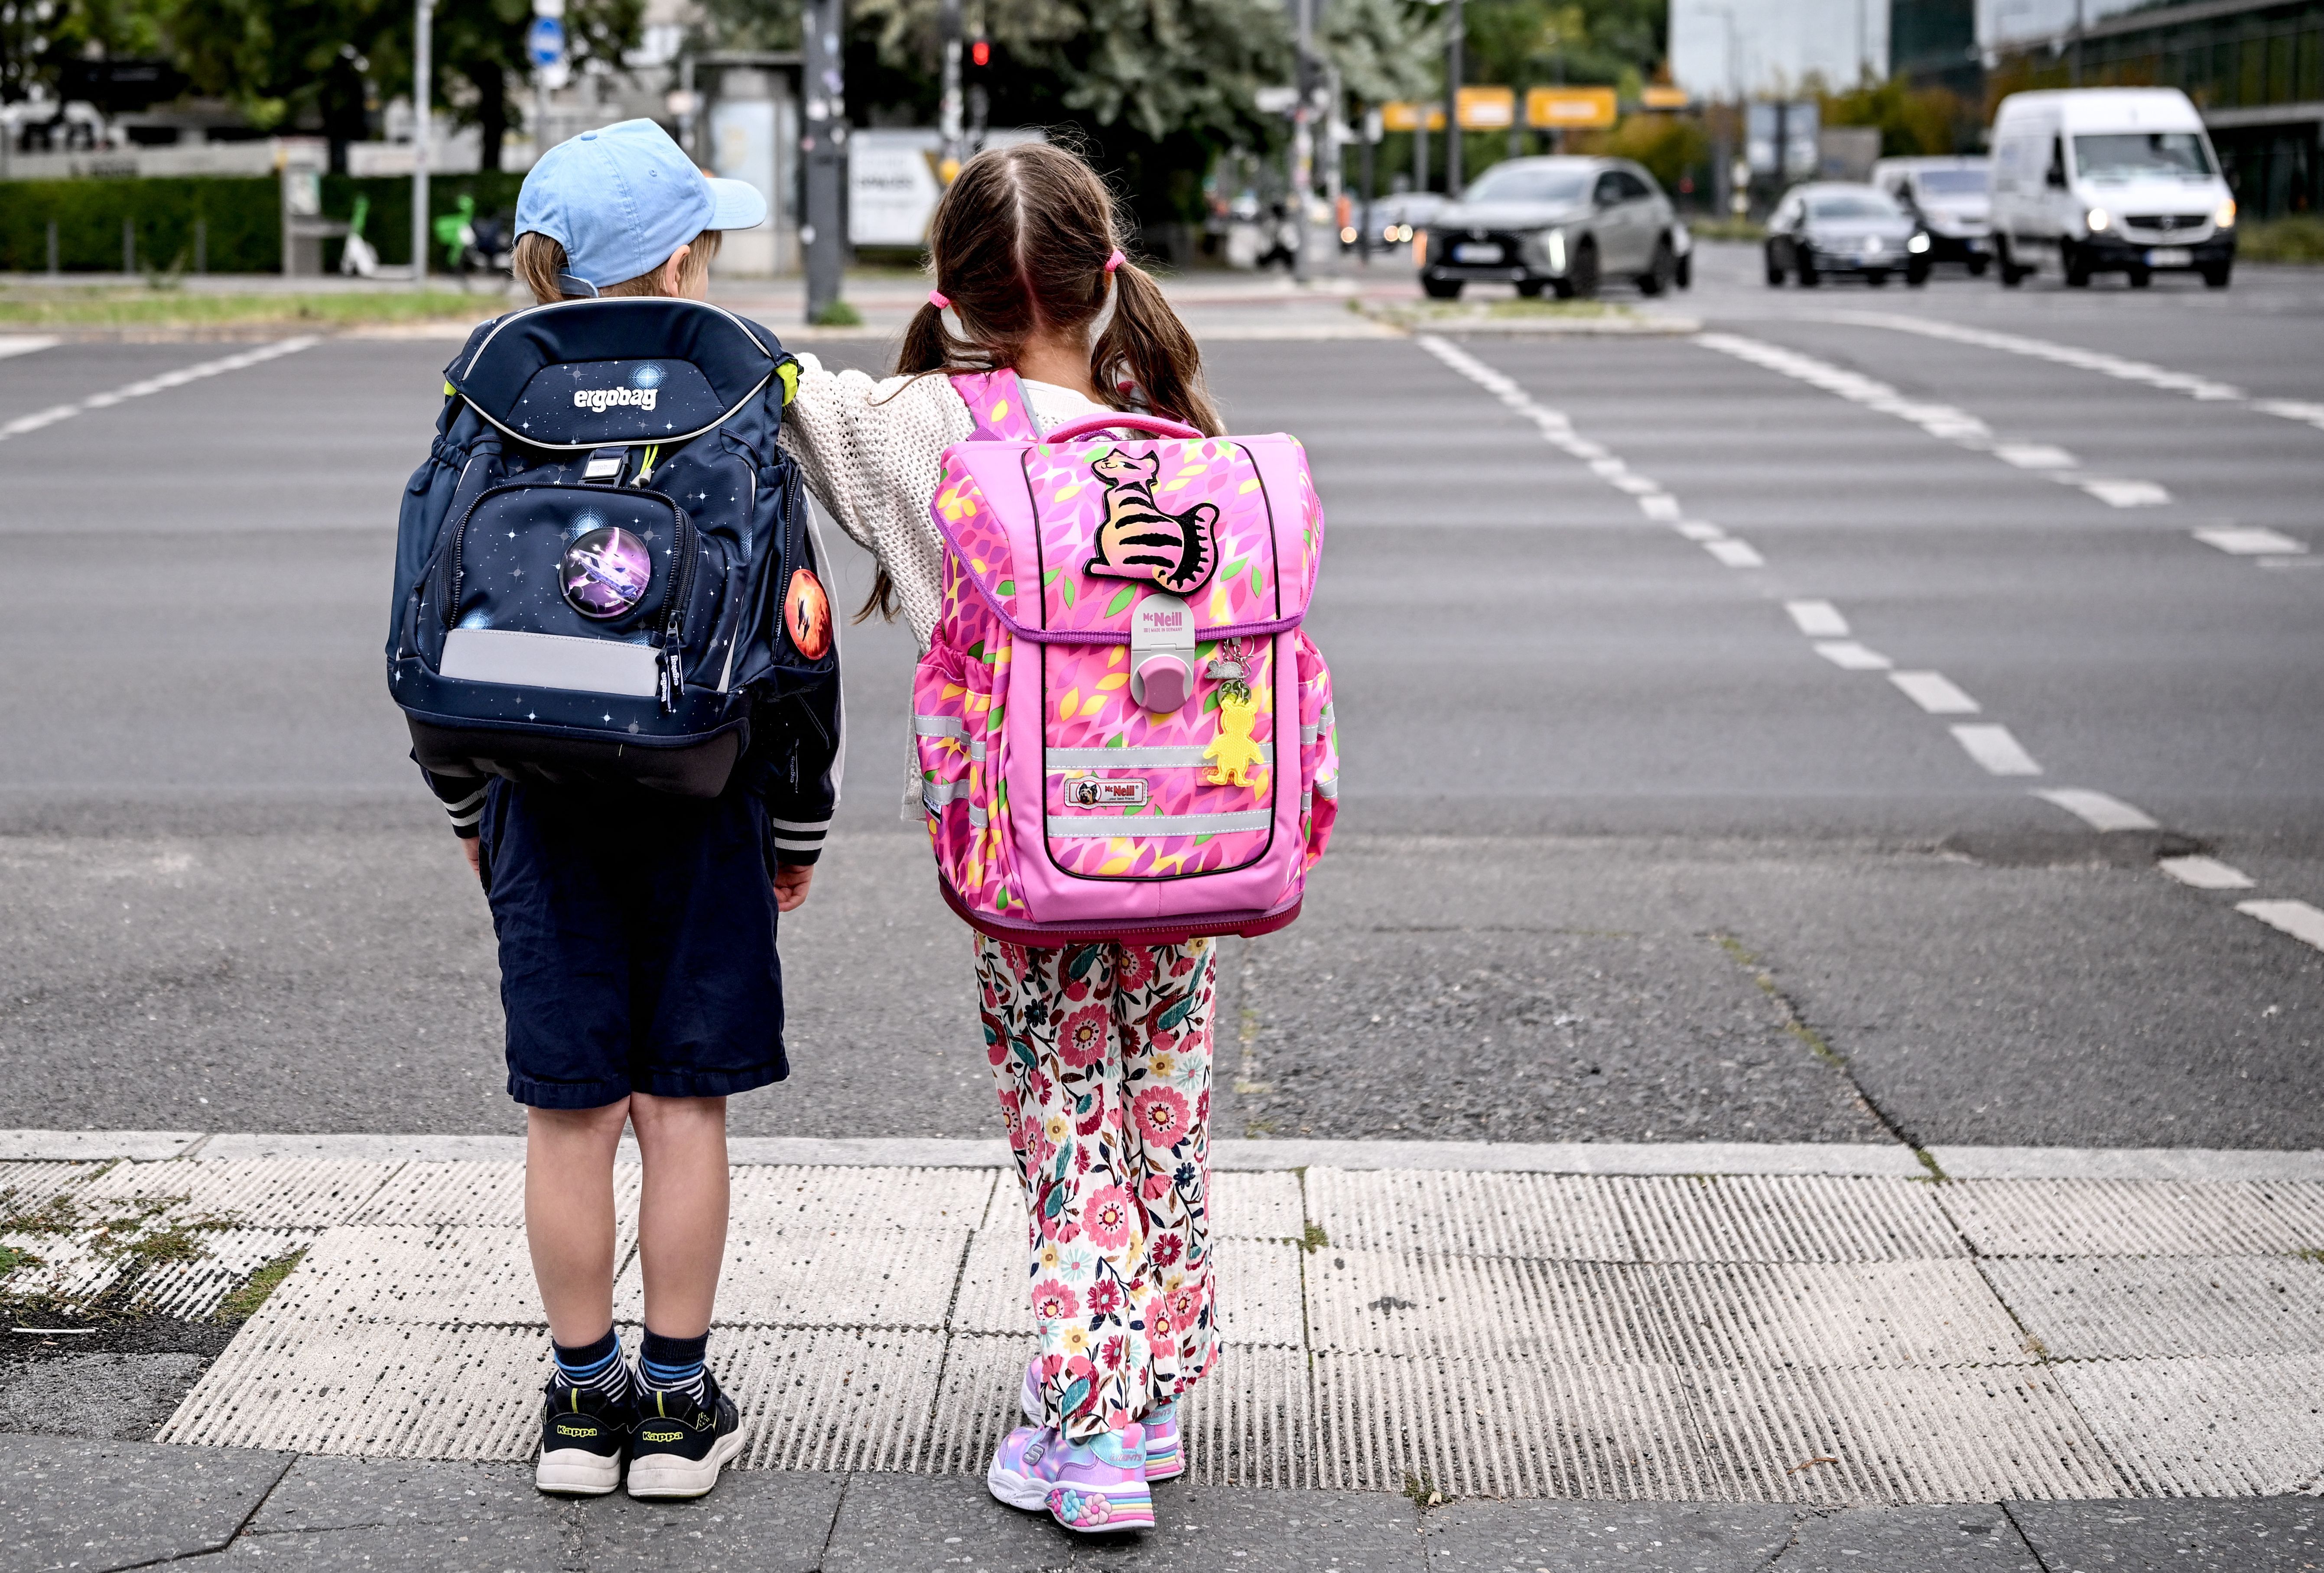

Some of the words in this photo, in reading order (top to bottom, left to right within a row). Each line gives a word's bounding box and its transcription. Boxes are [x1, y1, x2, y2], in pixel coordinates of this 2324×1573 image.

[574, 386, 658, 412] ergobag
[670, 655, 679, 686] ergobag
[1202, 767, 1219, 775] Craz
[557, 1425, 597, 1437] Kappa
[643, 1431, 683, 1442] Kappa
